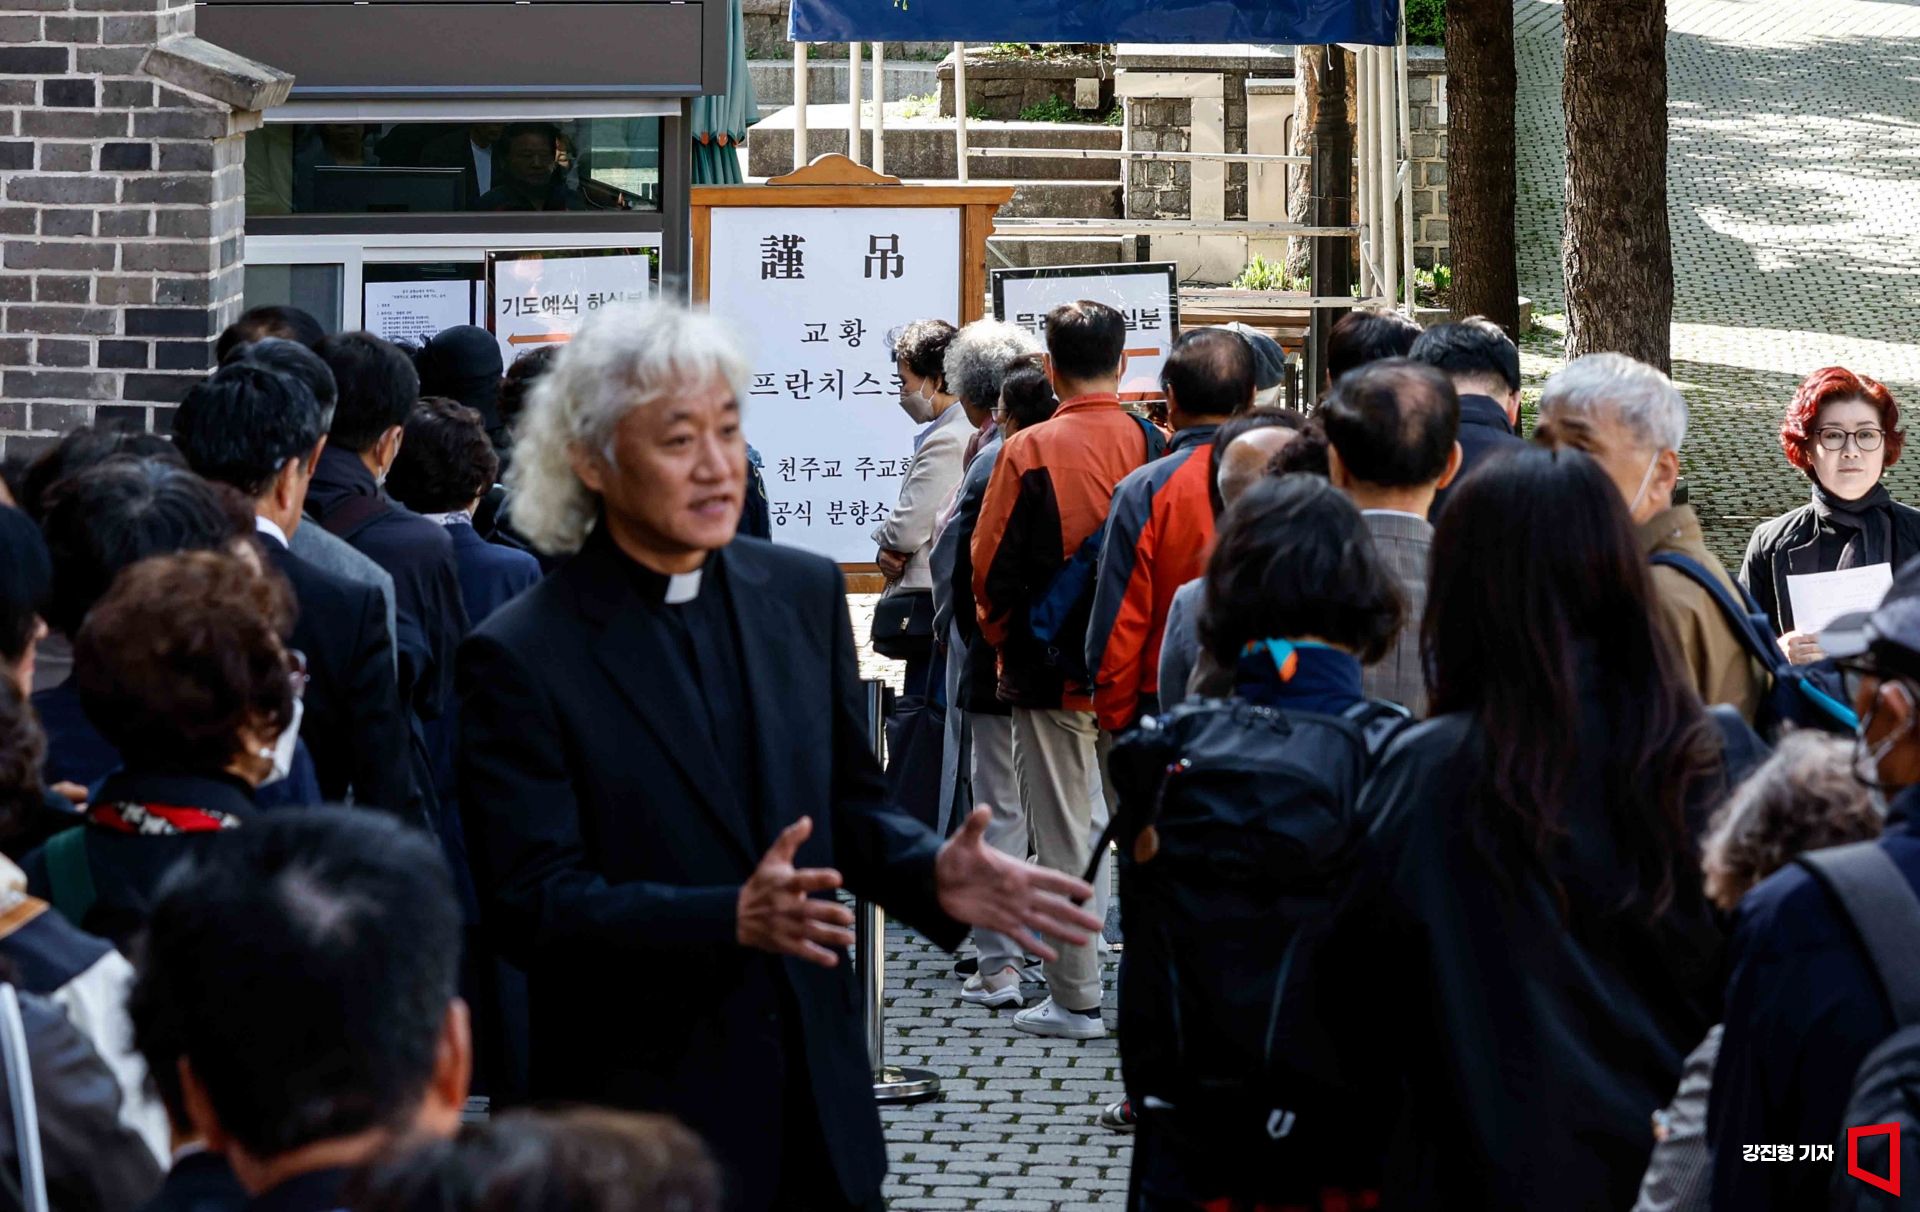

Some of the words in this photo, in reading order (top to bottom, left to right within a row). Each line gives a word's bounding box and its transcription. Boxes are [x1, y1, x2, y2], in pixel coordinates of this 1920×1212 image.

[760, 233, 806, 280] 謹
[502, 293, 579, 318] 기도예식
[800, 318, 867, 348] 교황
[777, 456, 843, 482] 천주교
[771, 499, 813, 527] 공식
[826, 499, 890, 526] 분향소
